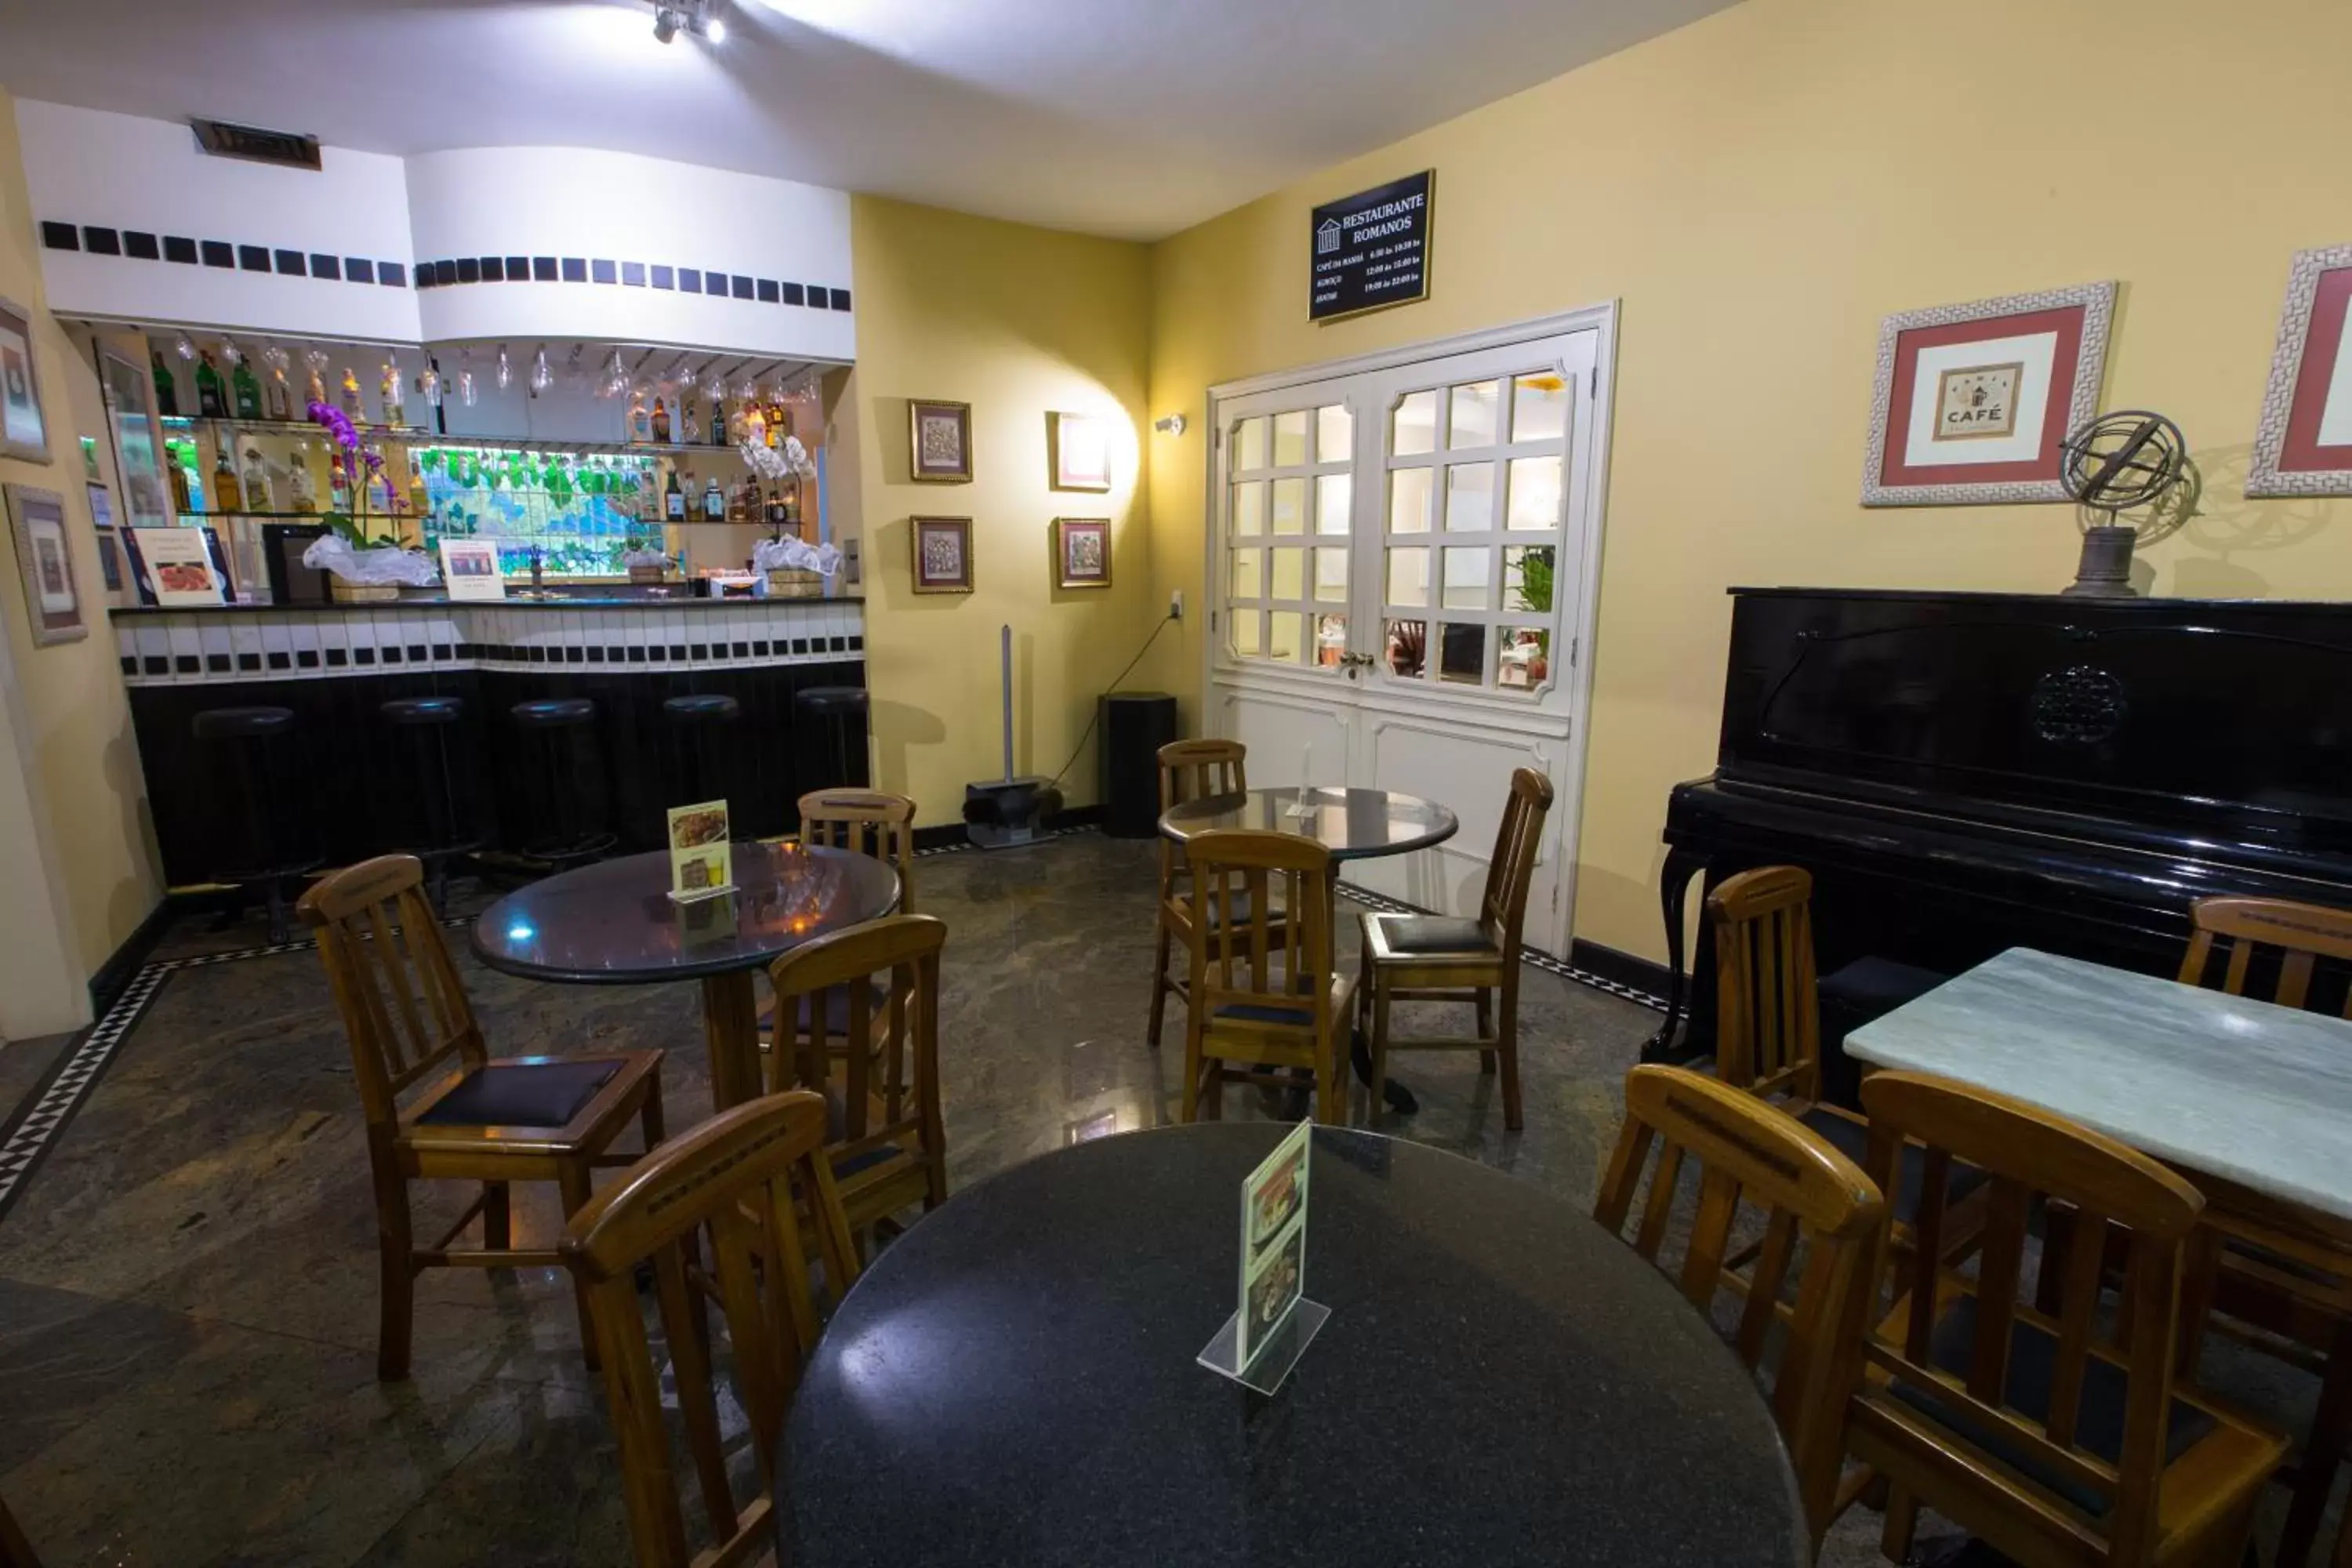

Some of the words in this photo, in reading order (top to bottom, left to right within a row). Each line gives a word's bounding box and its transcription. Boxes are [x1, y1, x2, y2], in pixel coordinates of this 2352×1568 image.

[1342, 194, 1424, 229] RESTAURANTE
[1353, 216, 1412, 244] ROMANOS
[1948, 403, 2002, 423] CAFÉ
